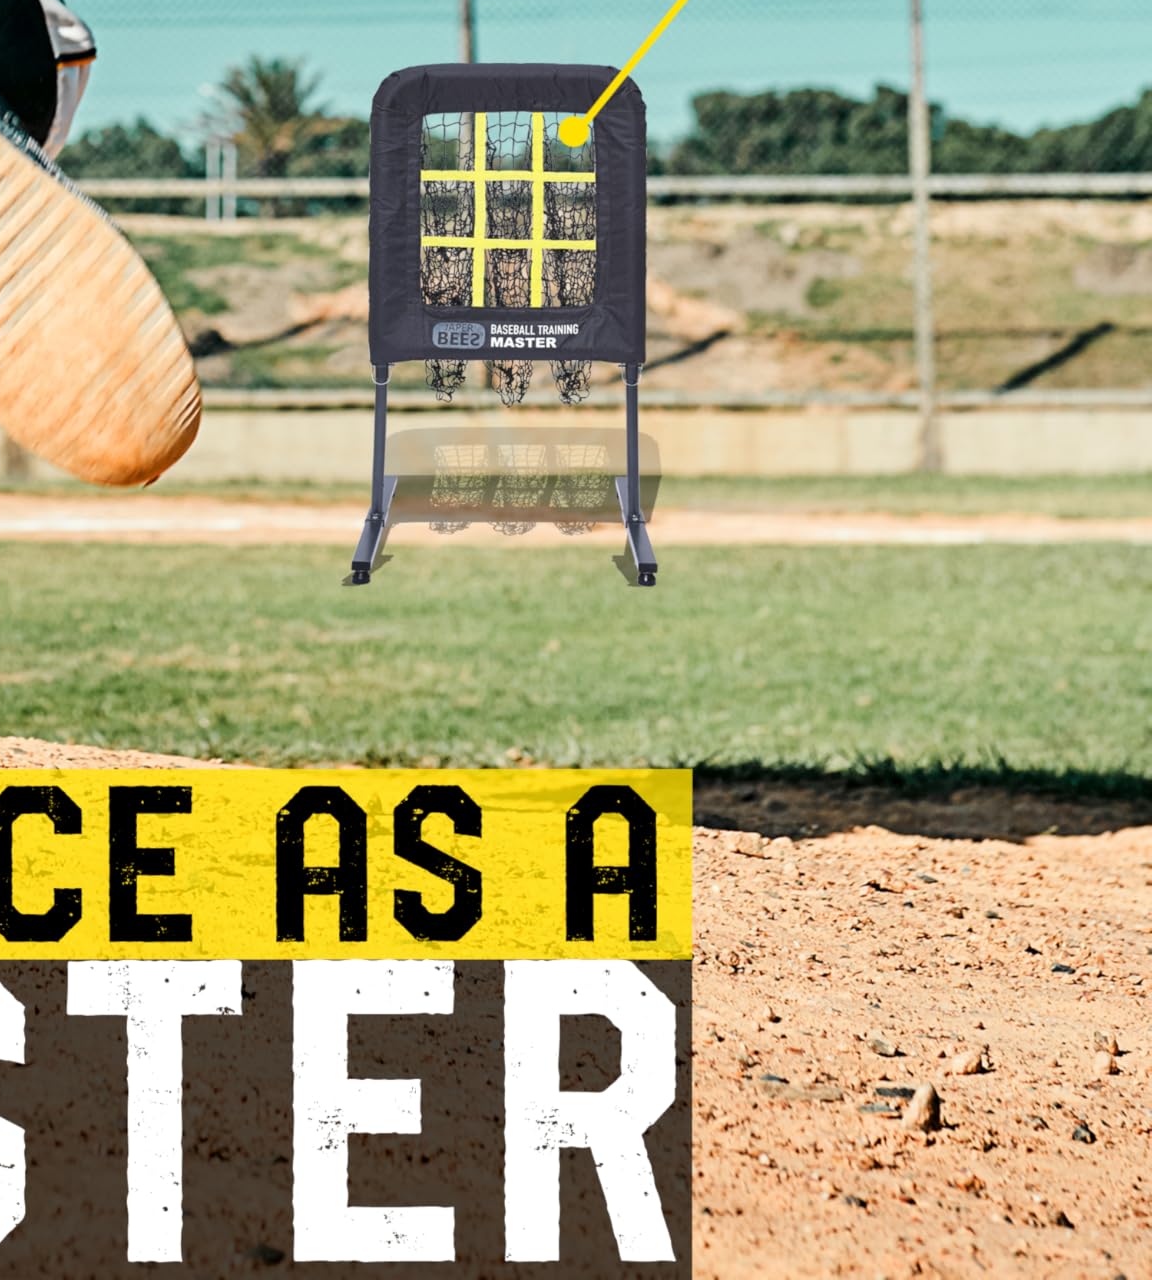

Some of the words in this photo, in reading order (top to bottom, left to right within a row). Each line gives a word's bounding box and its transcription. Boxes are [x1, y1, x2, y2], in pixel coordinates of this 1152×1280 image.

[490, 323, 535, 336] BASEBALL
[537, 323, 580, 336] TRAINING
[490, 336, 557, 349] MASTER
